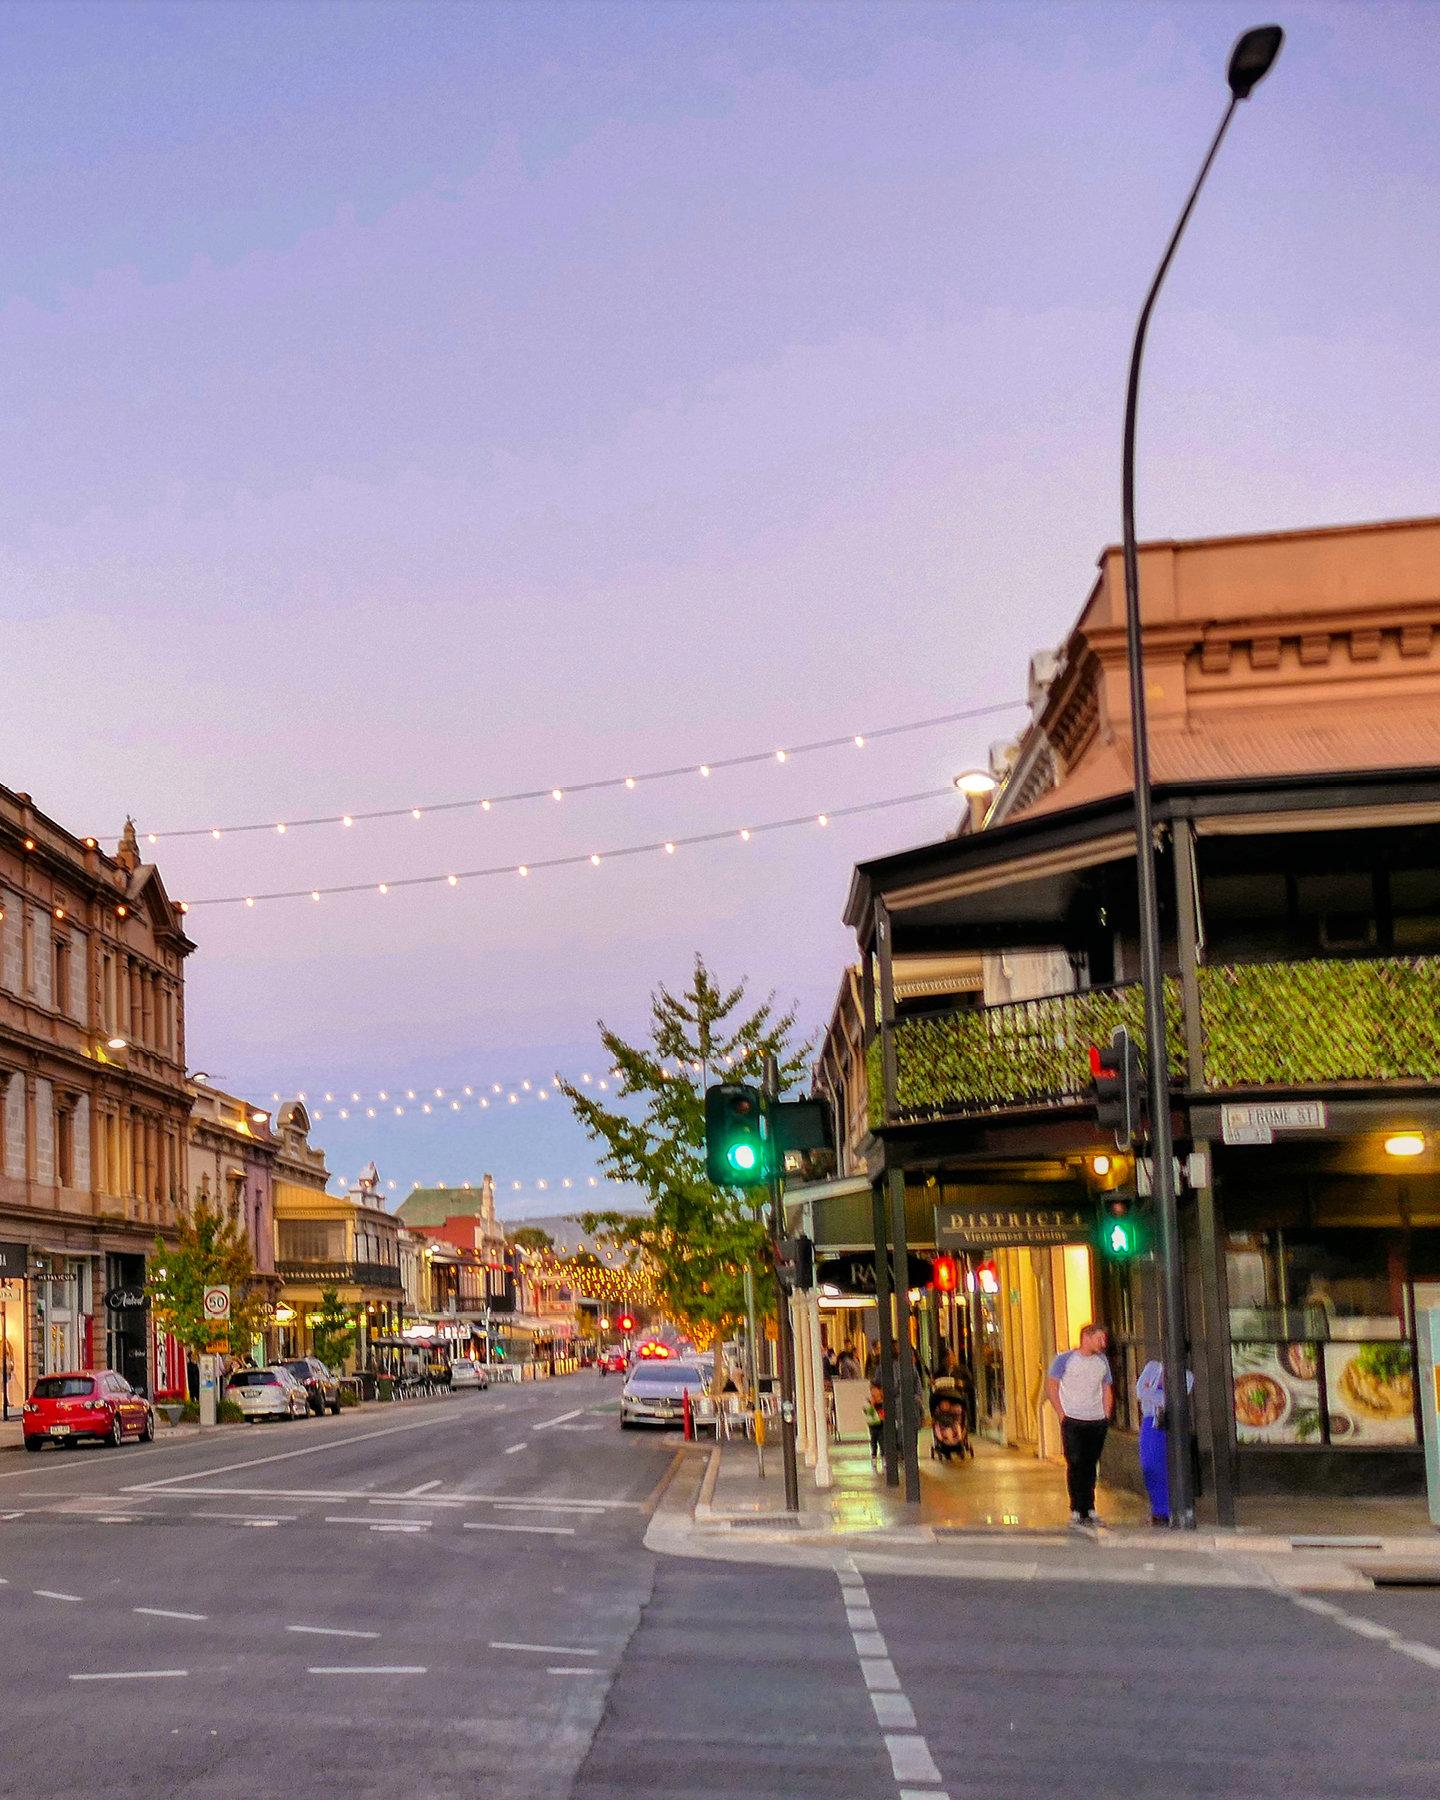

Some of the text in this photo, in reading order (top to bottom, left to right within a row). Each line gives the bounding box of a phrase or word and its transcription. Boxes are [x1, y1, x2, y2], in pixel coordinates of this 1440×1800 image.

[951, 1212, 1064, 1228] DISTRICT
[964, 1231, 1023, 1242] Vietnamese
[209, 1296, 225, 1308] 50
